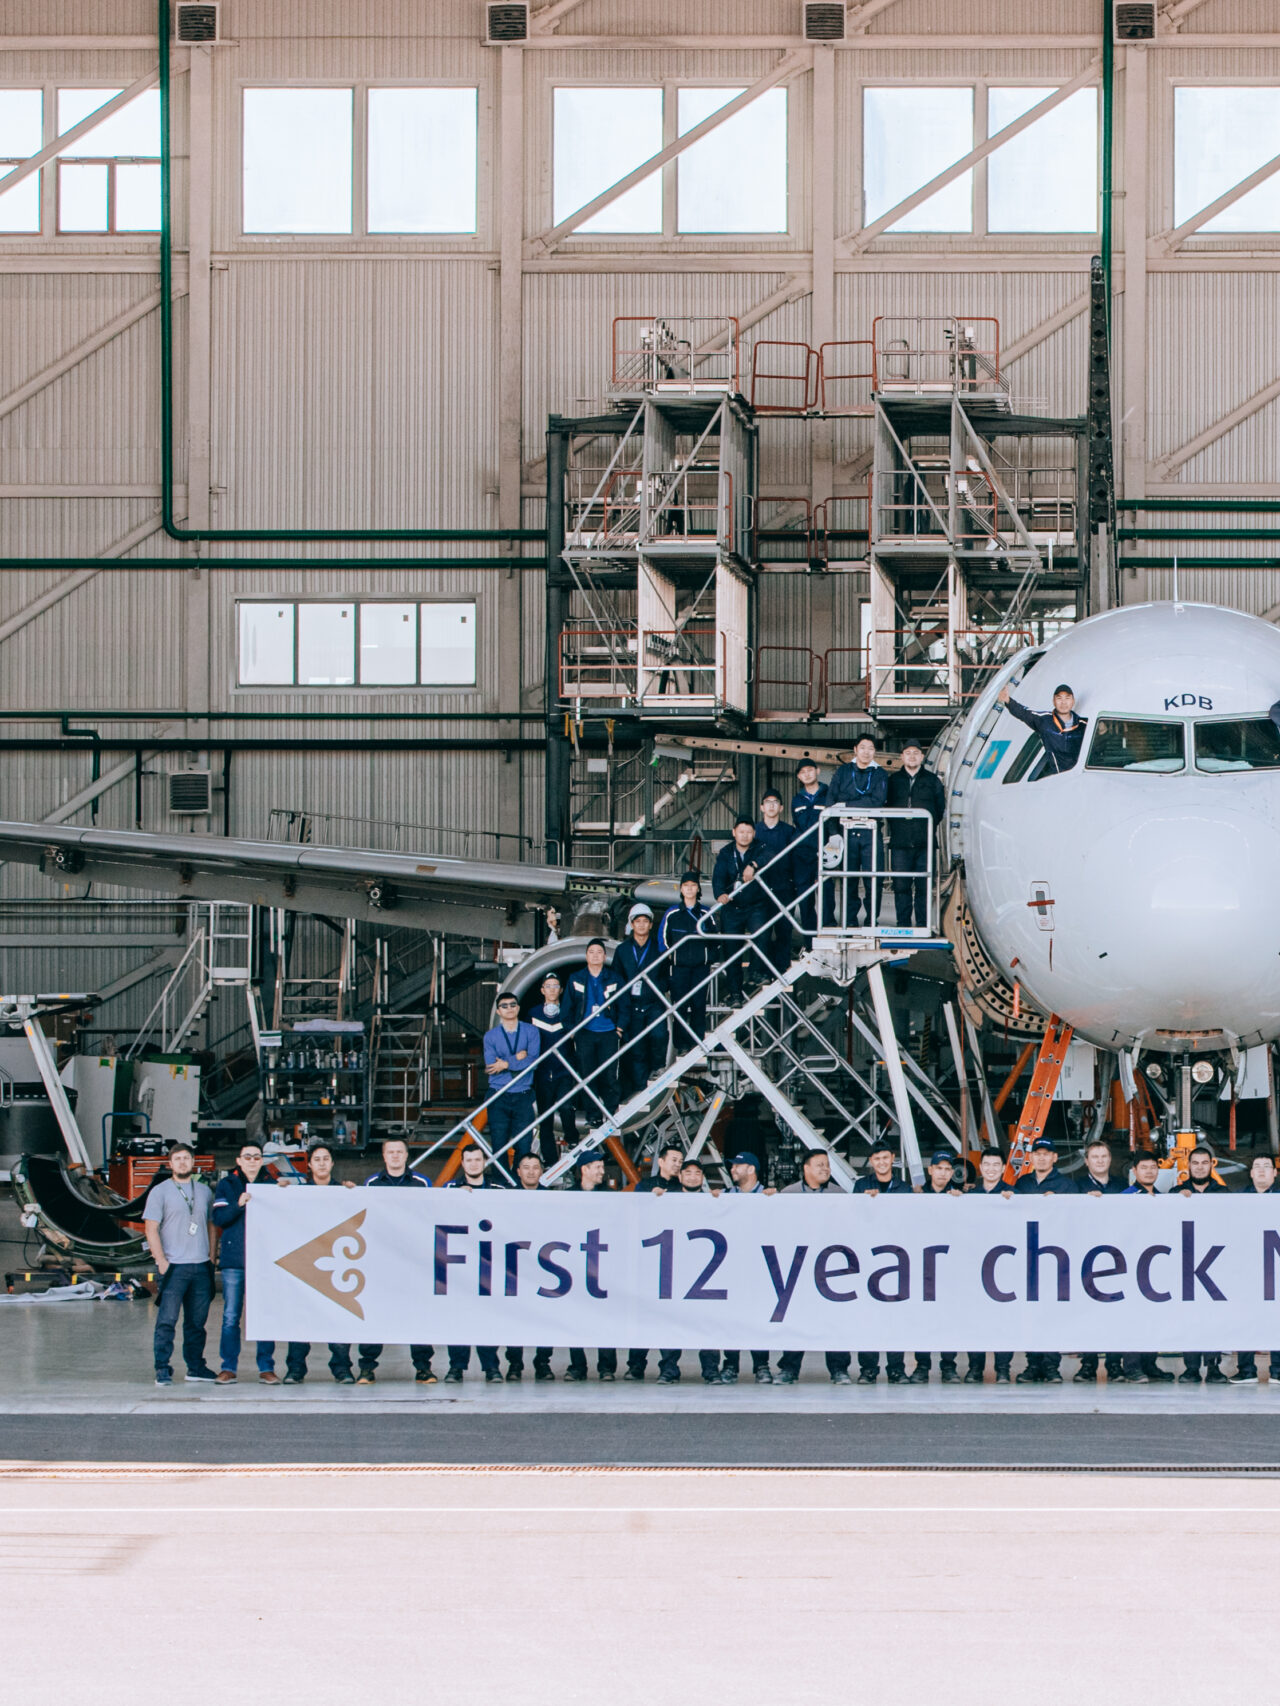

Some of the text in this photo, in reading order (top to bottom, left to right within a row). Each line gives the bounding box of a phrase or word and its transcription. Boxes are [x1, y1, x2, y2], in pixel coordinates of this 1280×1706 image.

[1164, 693, 1213, 711] KDB
[434, 1219, 608, 1299] First
[641, 1229, 727, 1300] 12
[760, 1243, 949, 1321] year
[980, 1220, 1228, 1302] check
